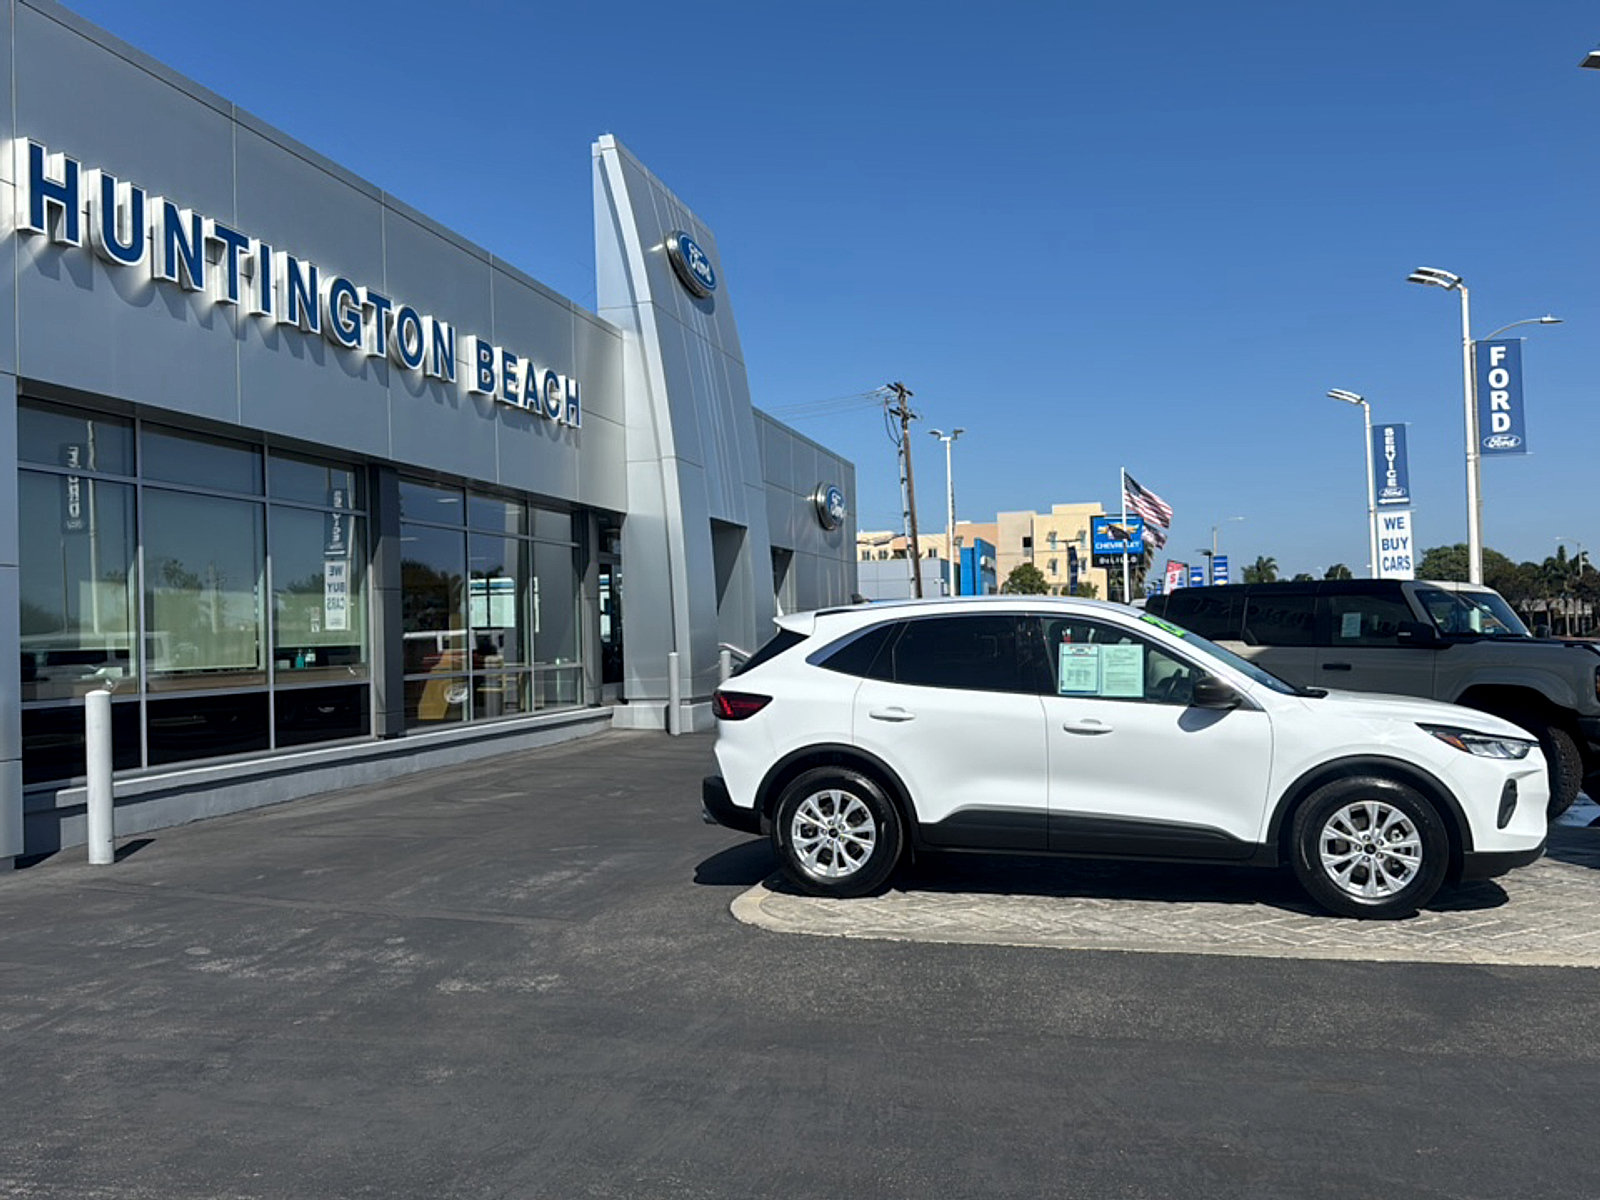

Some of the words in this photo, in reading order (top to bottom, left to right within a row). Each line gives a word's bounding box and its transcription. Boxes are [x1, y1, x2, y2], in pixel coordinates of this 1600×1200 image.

[688, 242, 712, 283] Ford
[22, 139, 456, 383] HUNTINGTON
[473, 337, 580, 428] BEACH
[1488, 346, 1511, 433] FORD
[1488, 436, 1516, 449] Ford
[1384, 427, 1397, 487] SERVICE
[1384, 516, 1405, 530] WE
[1095, 541, 1140, 550] CHEVRLET
[1382, 537, 1408, 551] BUY
[1383, 555, 1411, 571] CARS
